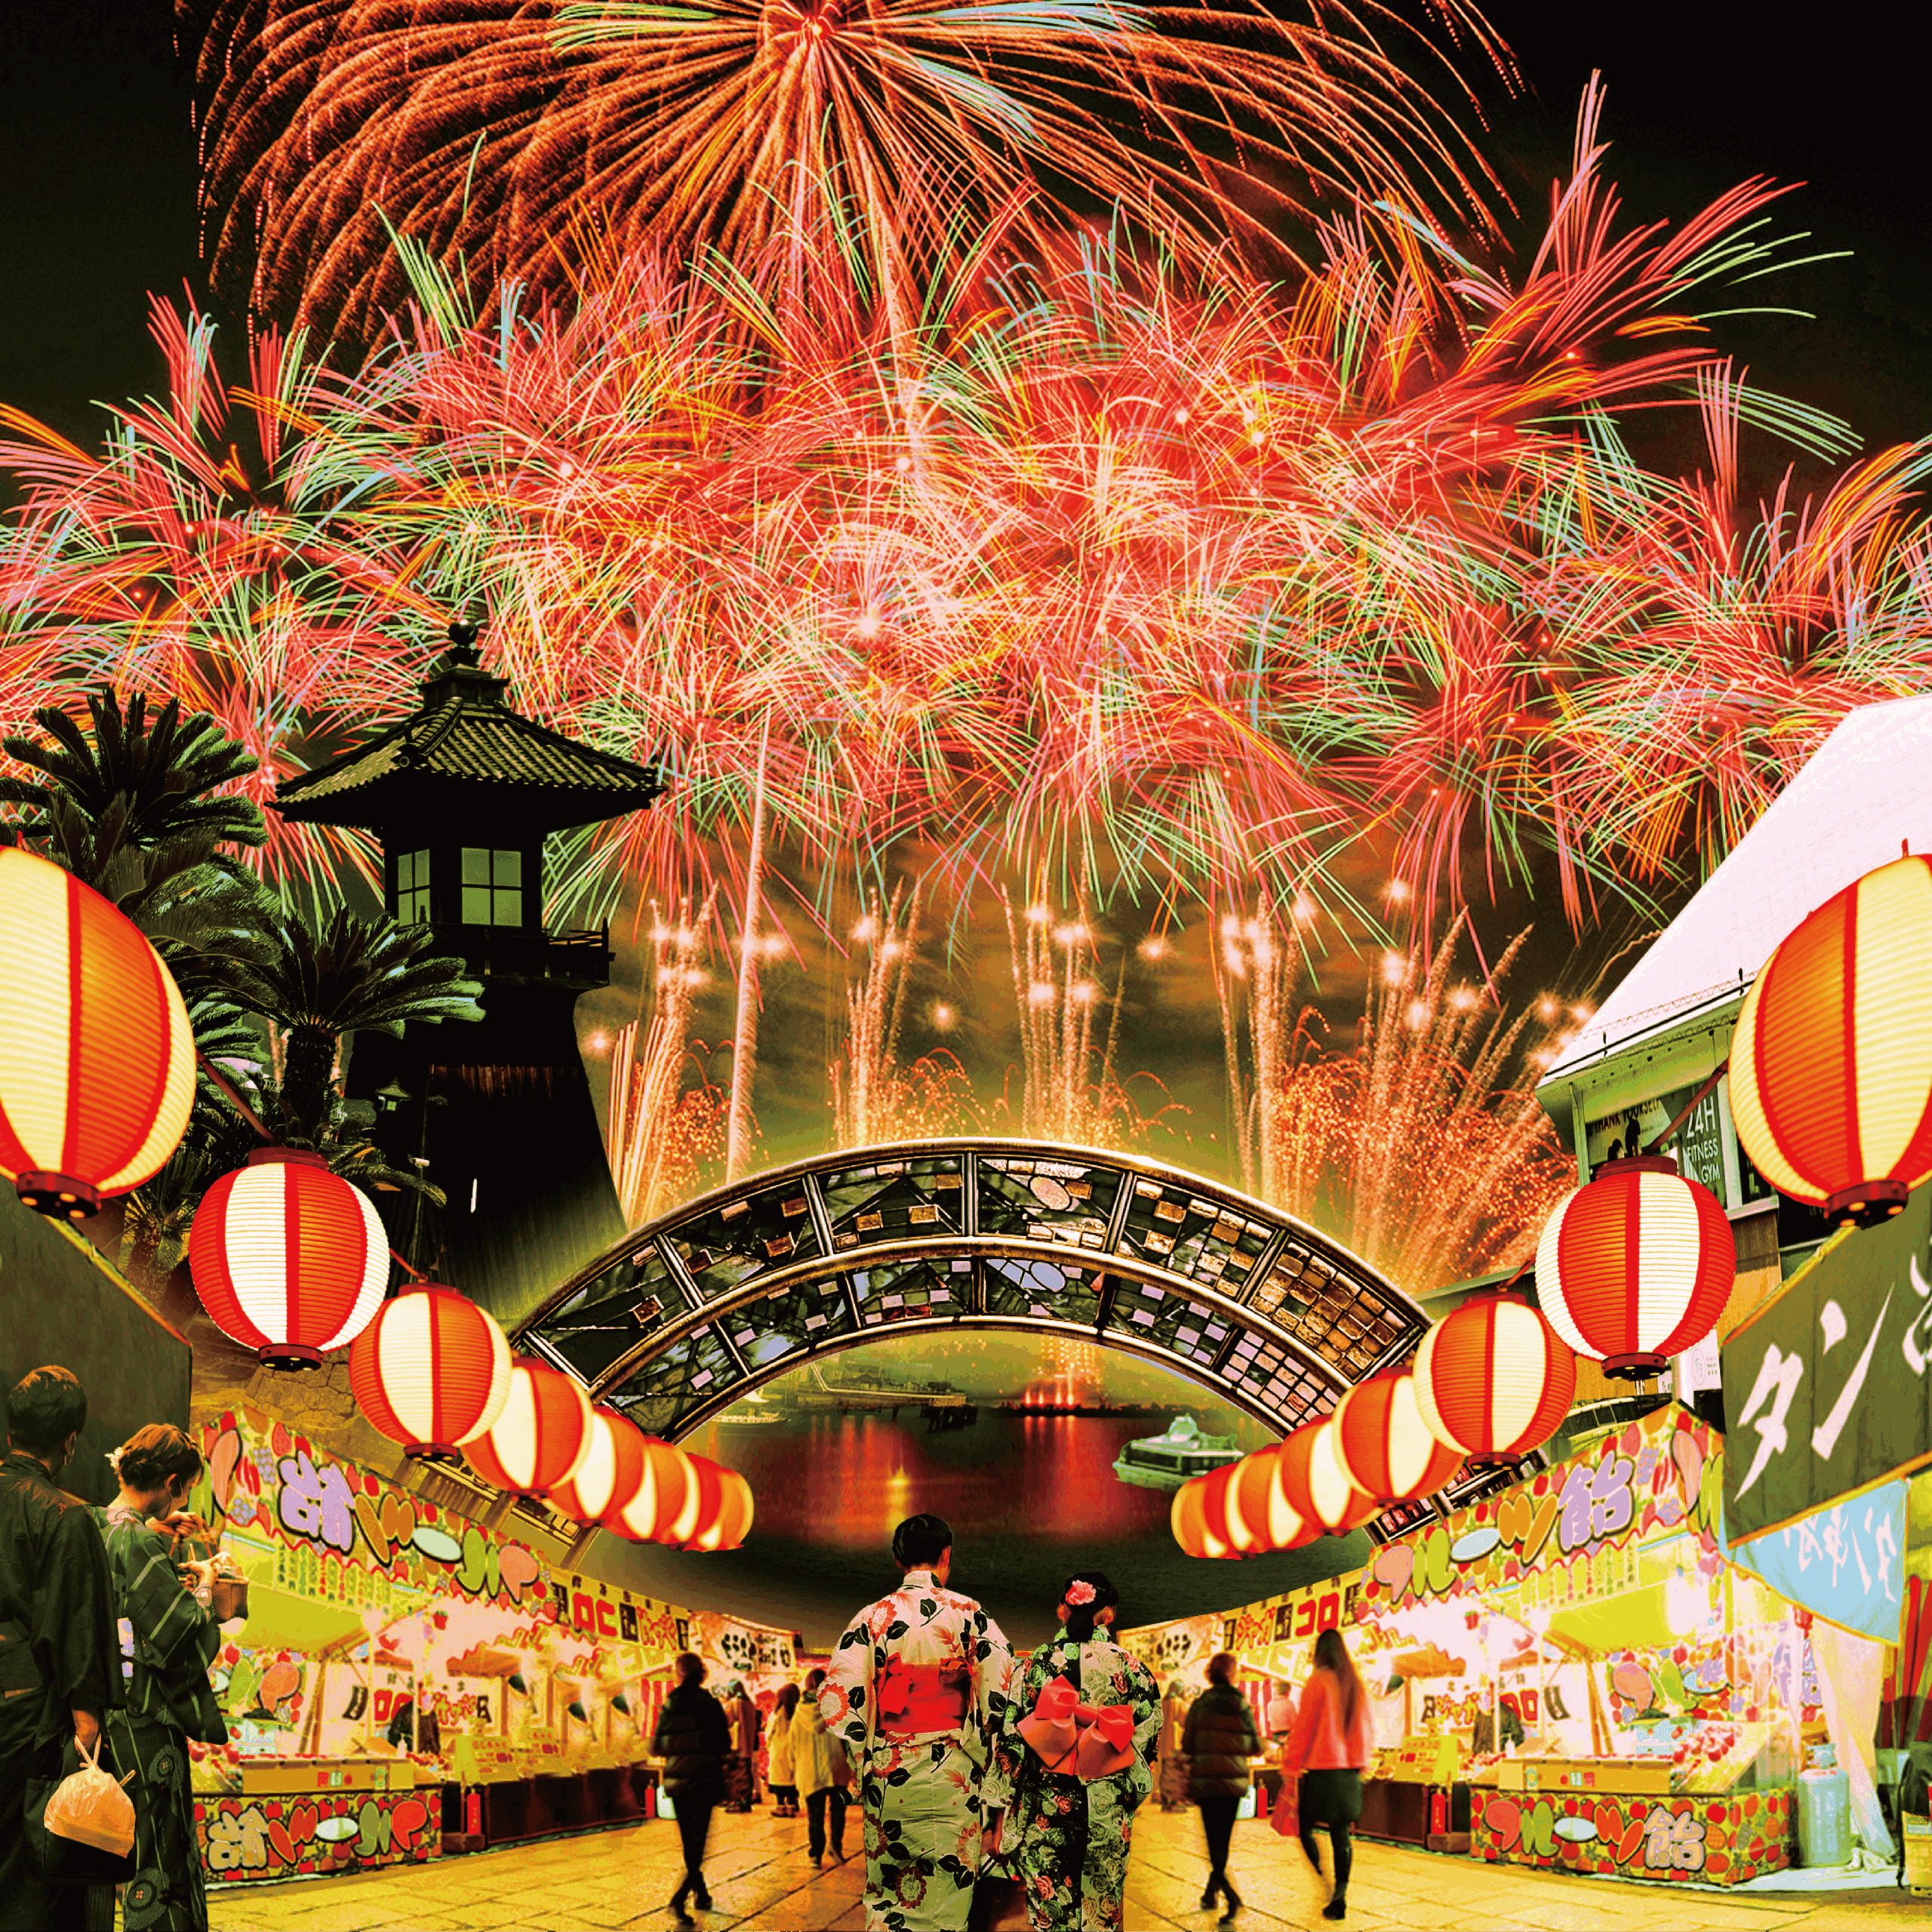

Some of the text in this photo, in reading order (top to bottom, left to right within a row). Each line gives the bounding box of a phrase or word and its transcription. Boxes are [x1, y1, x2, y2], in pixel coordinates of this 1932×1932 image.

[1687, 1138, 1718, 1162] FITNESS
[1701, 1164, 1721, 1183] GYM
[1372, 1450, 1635, 1604] フルーツ飴
[1484, 1798, 1706, 1872] フルーツ飴
